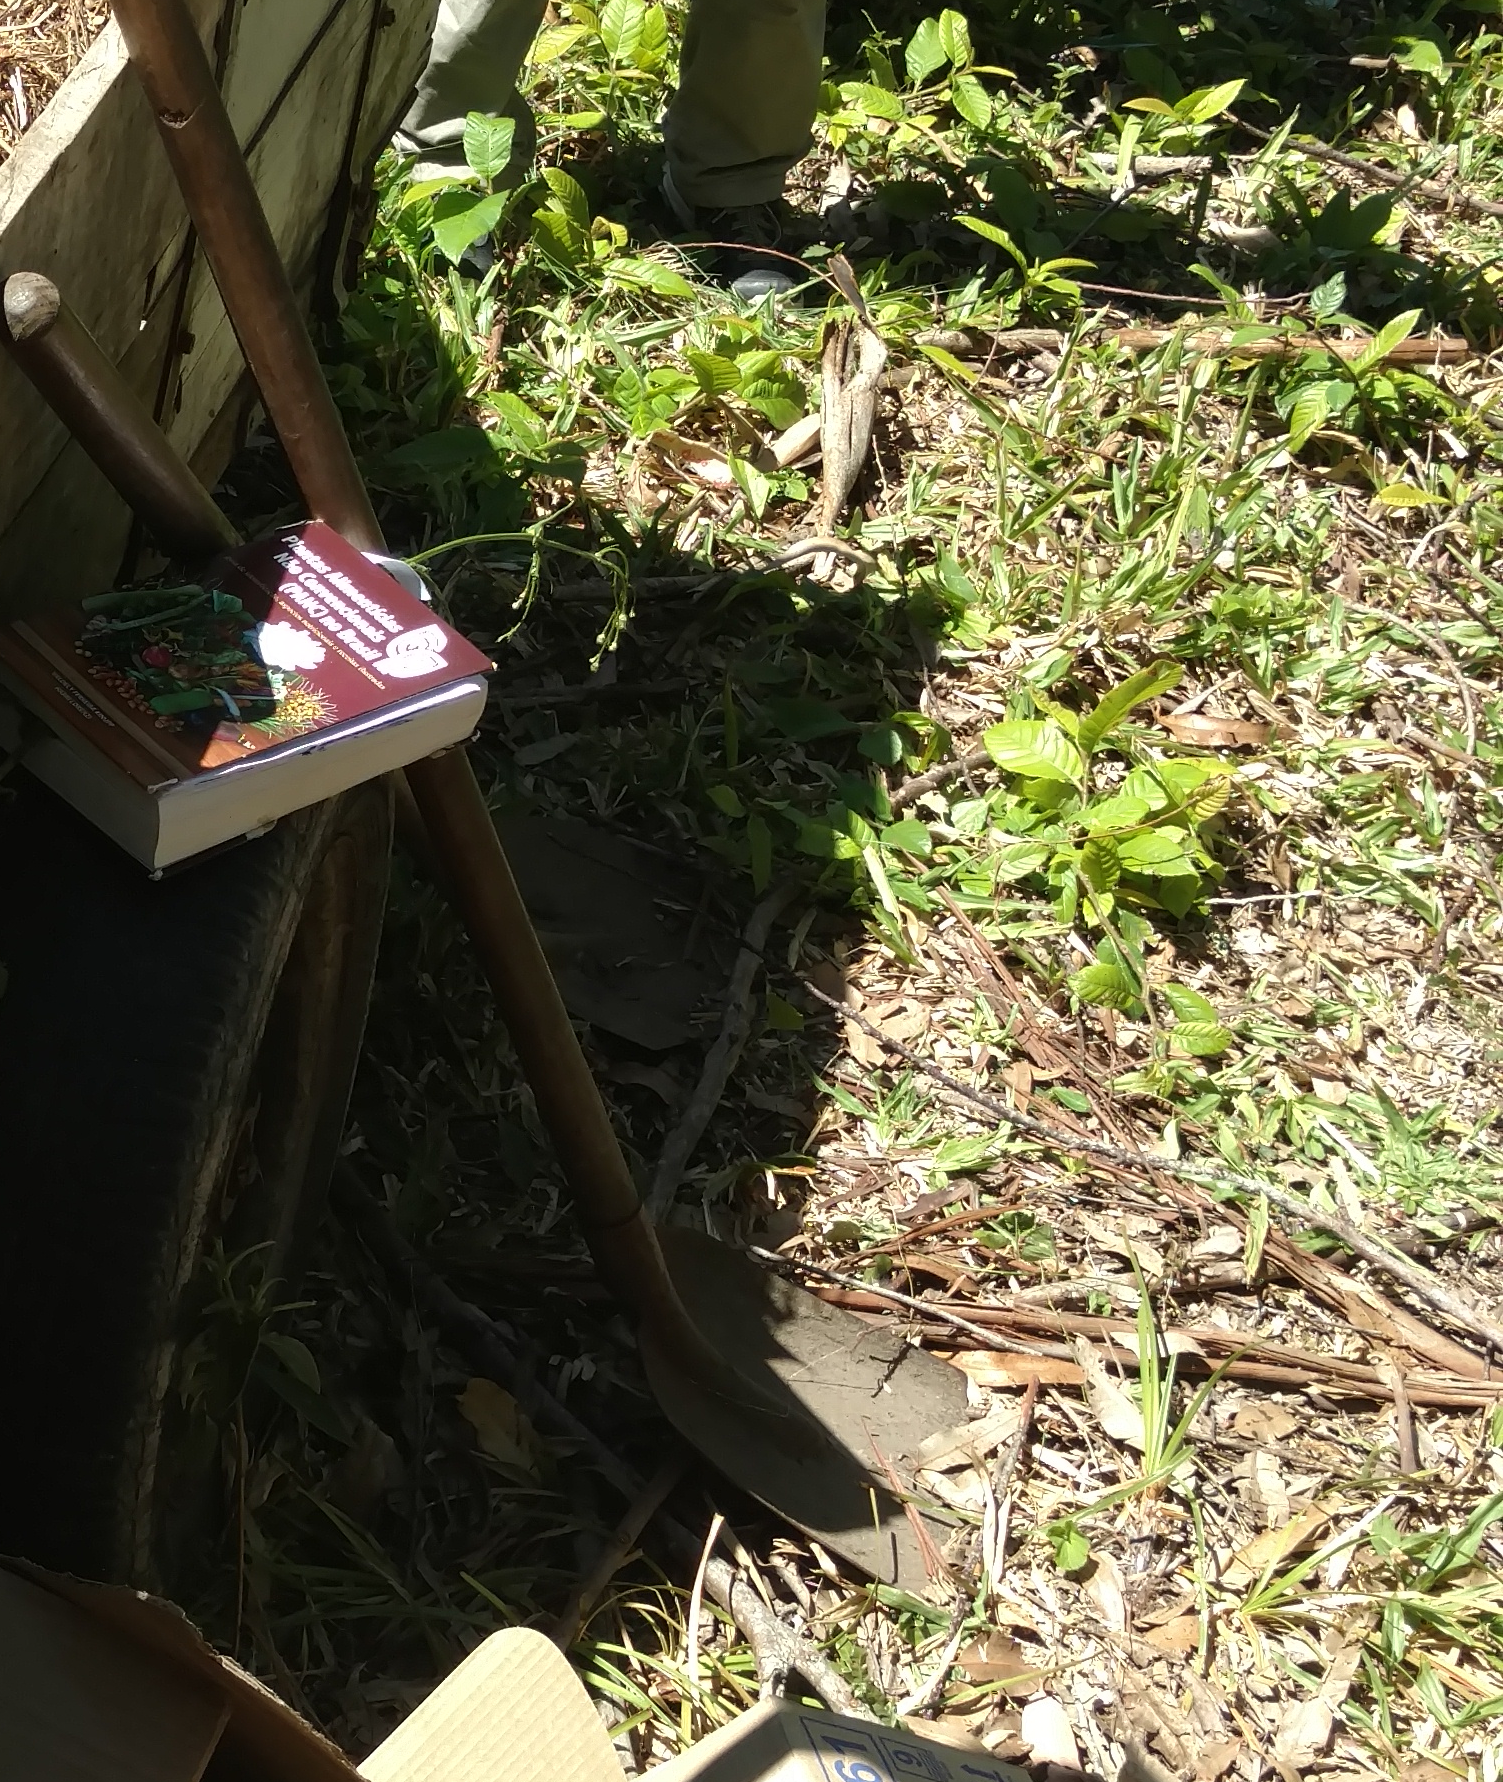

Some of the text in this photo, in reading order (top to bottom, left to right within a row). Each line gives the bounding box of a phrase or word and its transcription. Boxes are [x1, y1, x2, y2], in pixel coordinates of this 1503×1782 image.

[281, 535, 332, 574] Plantas
[273, 552, 303, 575] Não
[298, 572, 387, 643] Convencionais
[278, 582, 328, 618] (PANC)
[318, 613, 342, 631] no
[336, 629, 382, 661] Brasil
